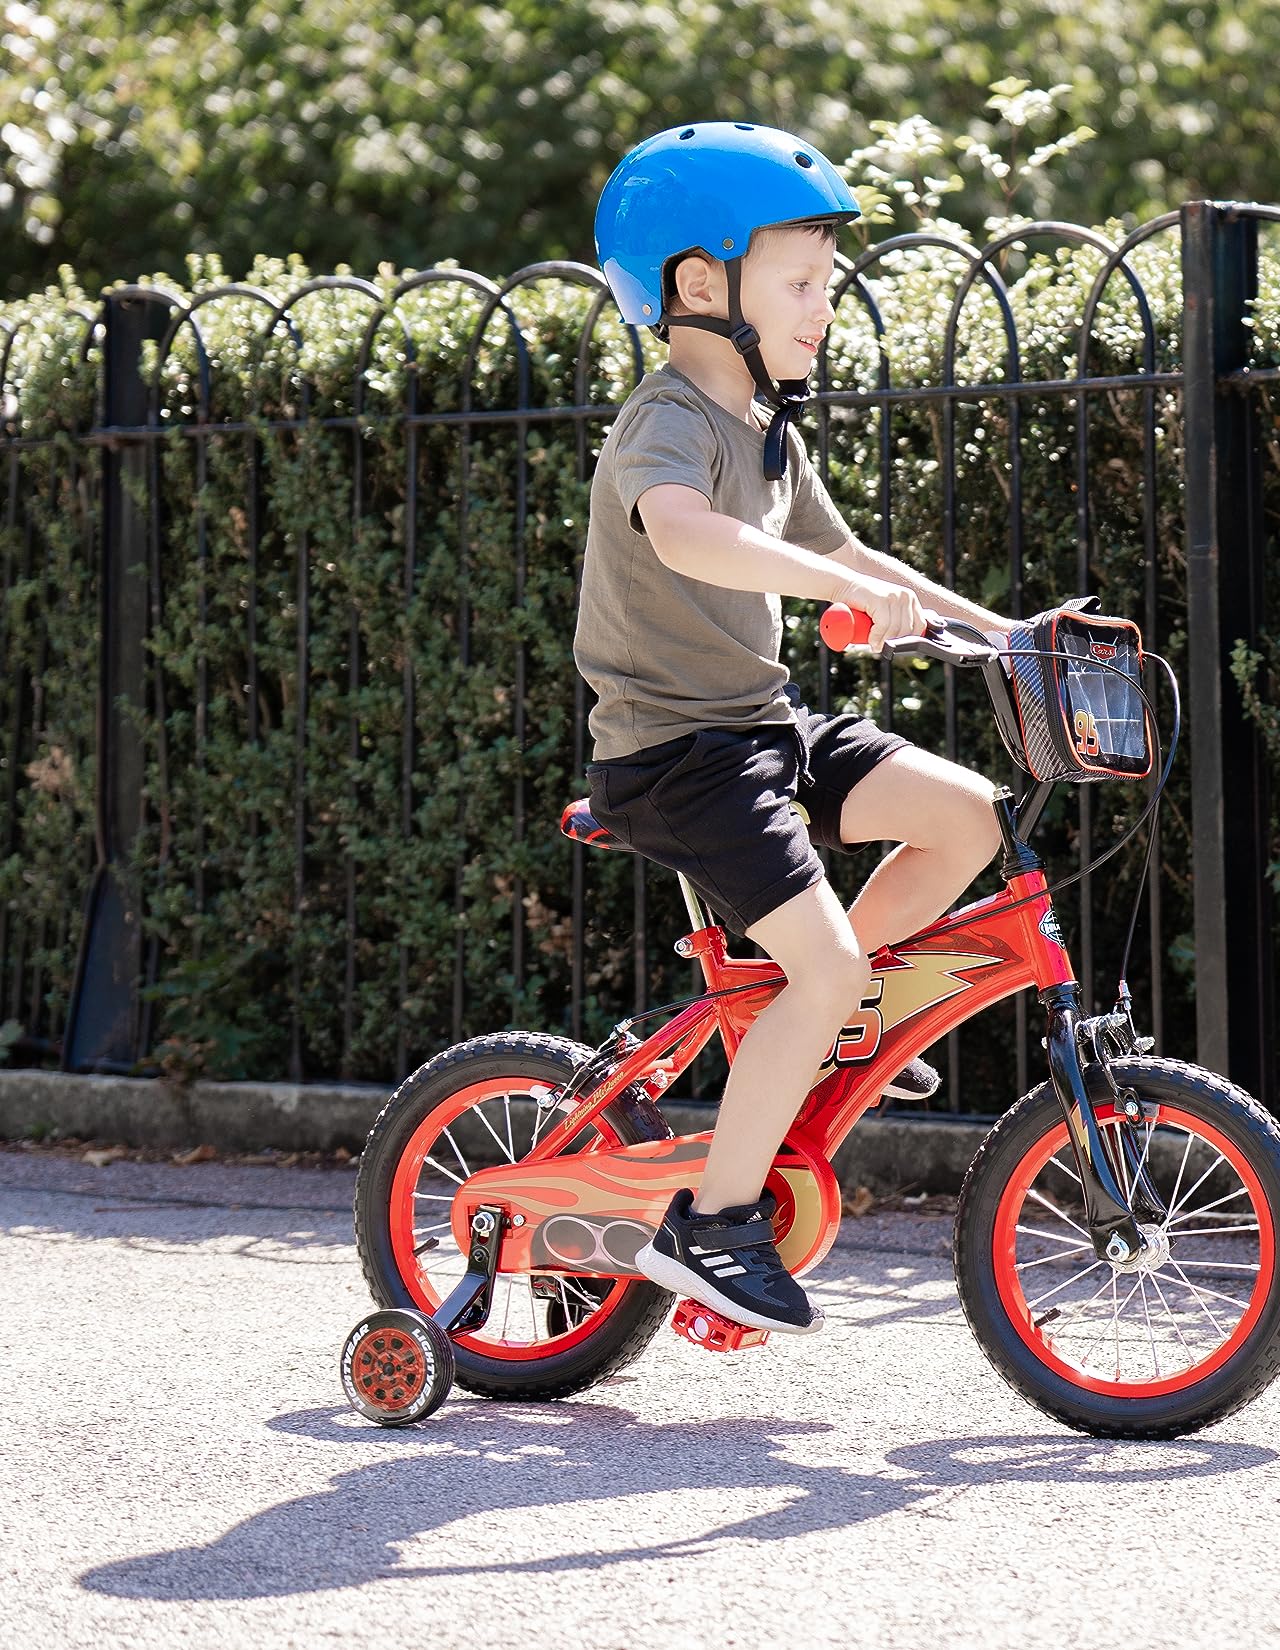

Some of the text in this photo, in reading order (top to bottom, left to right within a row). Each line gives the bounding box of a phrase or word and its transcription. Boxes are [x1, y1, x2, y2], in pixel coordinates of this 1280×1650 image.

[1092, 644, 1114, 657] Cars
[1074, 708, 1099, 757] 95
[818, 976, 884, 1070] 5
[343, 1323, 370, 1411] LIGHTYEAR
[411, 1328, 435, 1415] LIGHTYEAR
